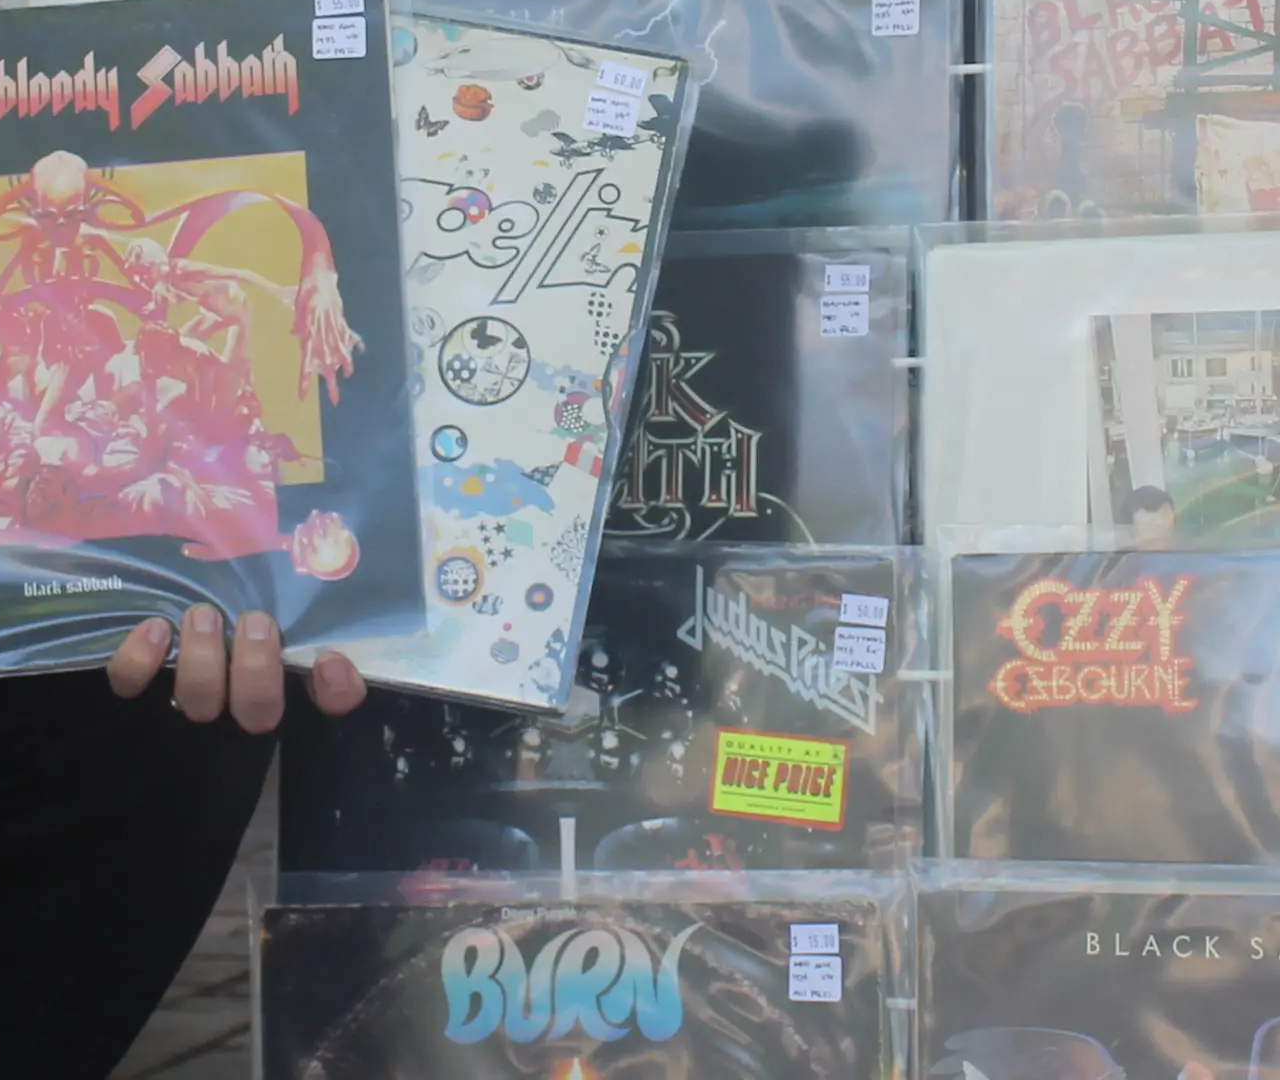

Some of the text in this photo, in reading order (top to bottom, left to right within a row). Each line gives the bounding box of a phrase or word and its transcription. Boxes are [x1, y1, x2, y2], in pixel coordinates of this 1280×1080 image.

[131, 32, 300, 131] Sabbath
[23, 574, 123, 597] black sabbath
[676, 563, 788, 676] Judas
[1000, 576, 1201, 662] OZZY
[790, 623, 884, 737] Priest
[988, 657, 1201, 713] OSBOURNE
[721, 756, 837, 798] NICE PRICE
[725, 740, 792, 755] QUALITY
[804, 749, 821, 757] AT
[1085, 931, 1221, 960] BLACK
[441, 920, 708, 1045] BURN
